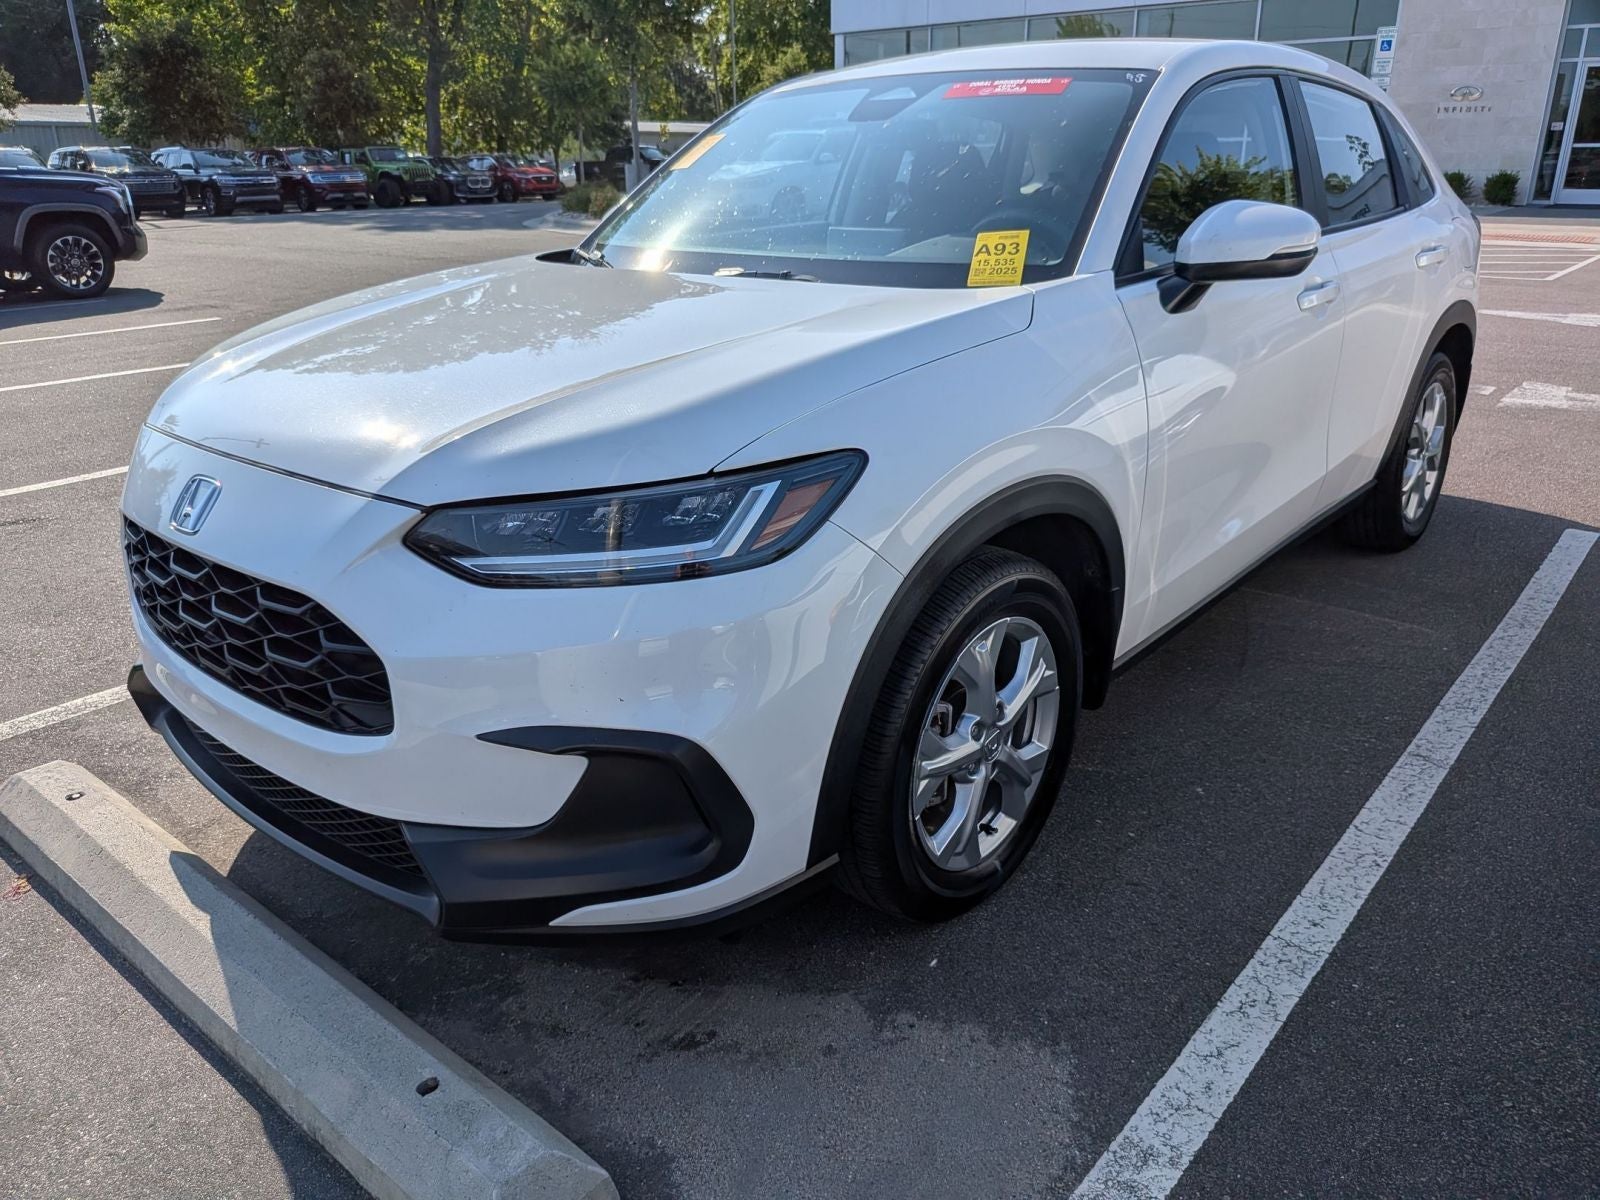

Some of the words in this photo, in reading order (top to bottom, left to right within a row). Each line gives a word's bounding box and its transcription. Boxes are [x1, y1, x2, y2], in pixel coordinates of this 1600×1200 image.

[1436, 105, 1492, 114] INFINITI
[974, 242, 1020, 257] A93
[976, 258, 1015, 267] 15,535
[988, 266, 1018, 276] 2025
